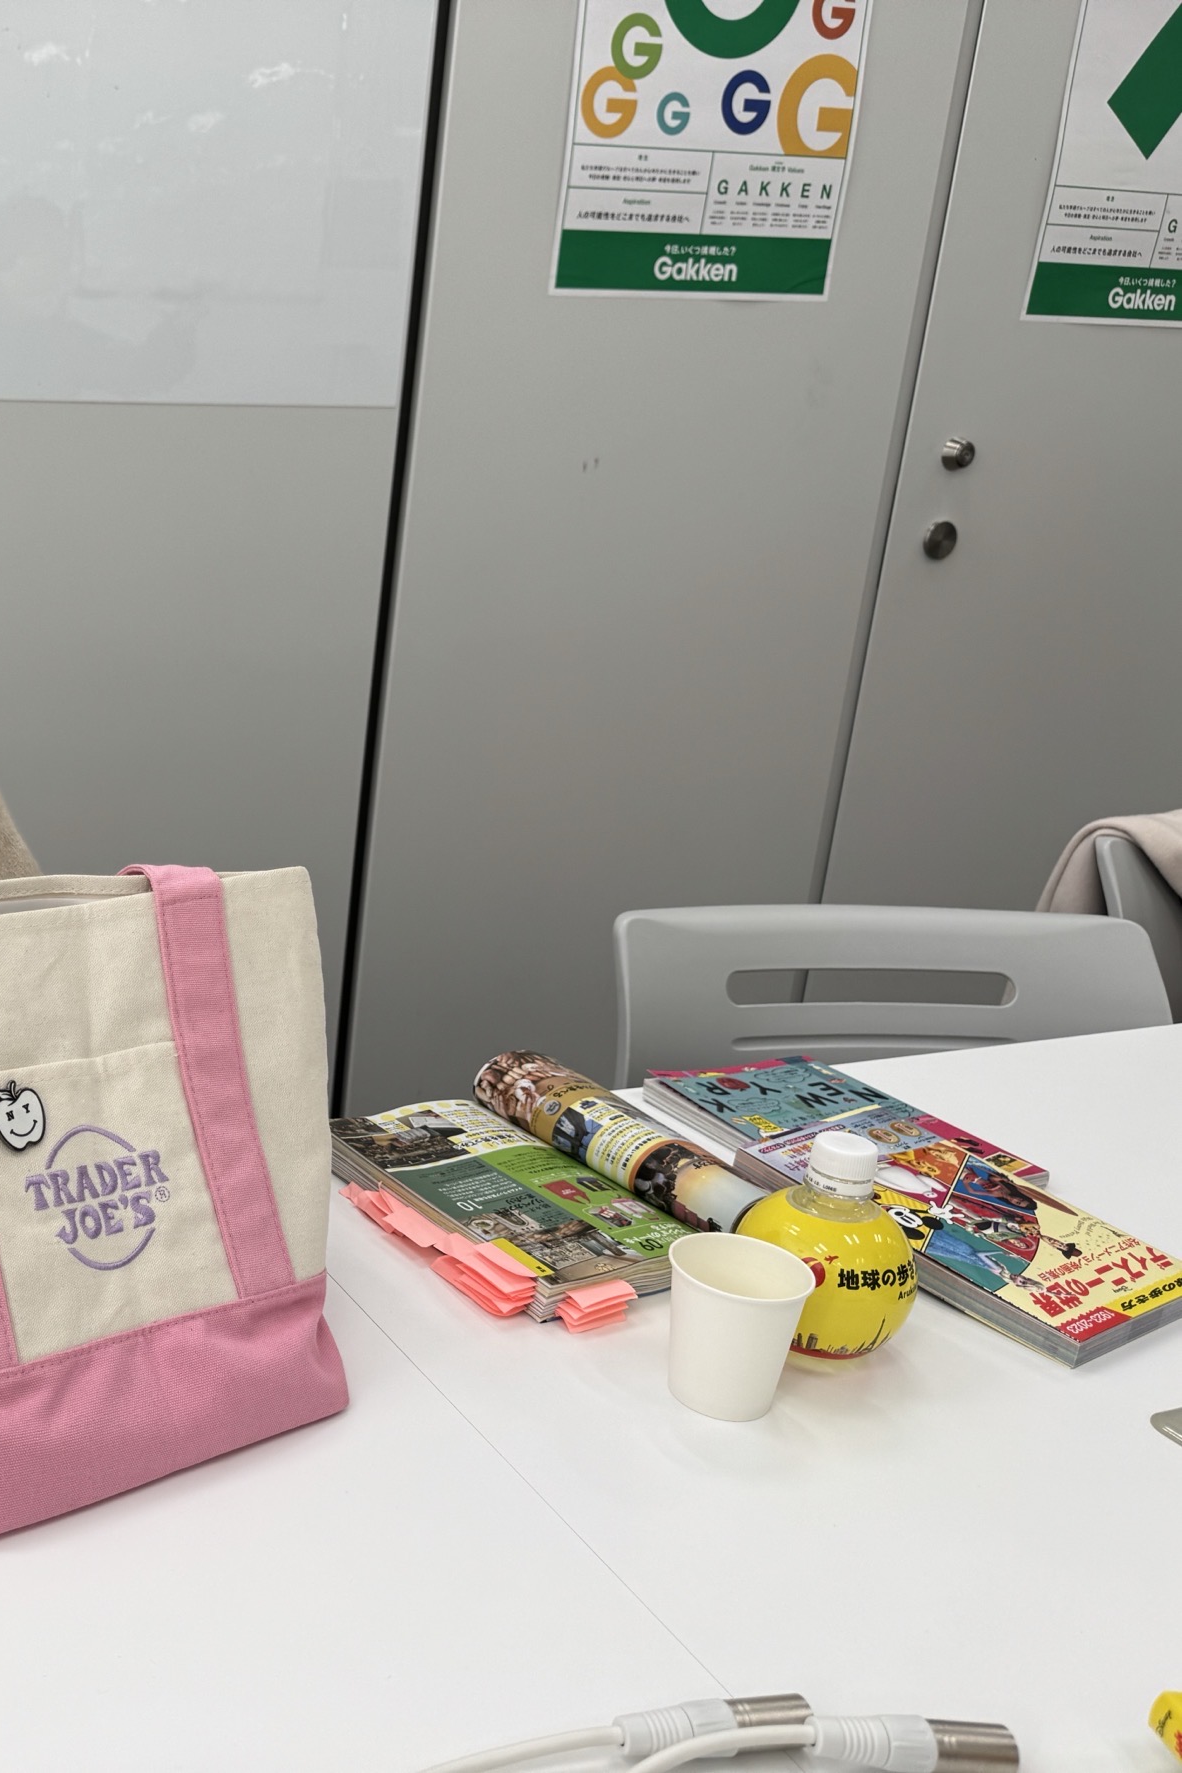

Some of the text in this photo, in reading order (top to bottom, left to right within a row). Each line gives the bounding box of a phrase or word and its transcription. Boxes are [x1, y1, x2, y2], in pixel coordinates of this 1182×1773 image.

[611, 12, 662, 79] G
[581, 66, 637, 139] G
[657, 92, 690, 135] G
[721, 70, 770, 135] G
[1089, 234, 1112, 242] Aspiration
[654, 257, 738, 282] Gakken
[1108, 287, 1176, 311] Gakken
[6, 1104, 30, 1121] N Y
[25, 1150, 169, 1211] TRADER
[56, 1191, 156, 1244] JOE'S
[457, 1198, 482, 1211] 10
[639, 1238, 660, 1251] 09
[1038, 1236, 1141, 1281] 名作アニメーション映画の舞台
[1030, 1247, 1174, 1318] ディズニーの世界
